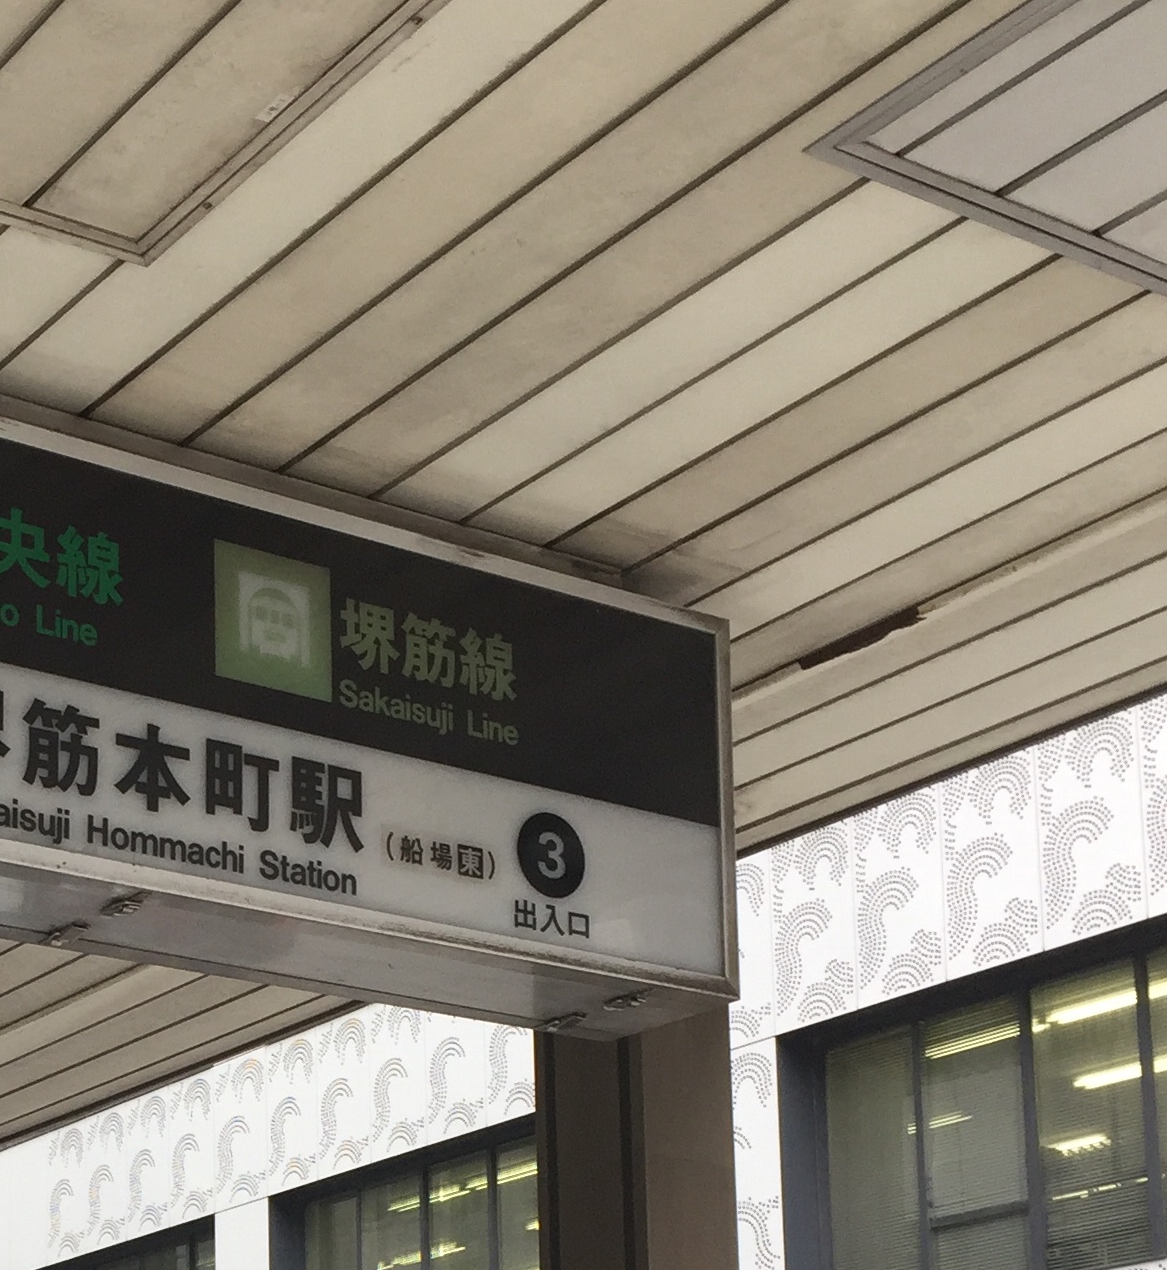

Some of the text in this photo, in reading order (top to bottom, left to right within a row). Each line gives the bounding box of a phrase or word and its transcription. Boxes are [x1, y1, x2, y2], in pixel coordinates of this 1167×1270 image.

[36, 608, 99, 647] Line
[339, 598, 518, 700] 堺筋線
[339, 679, 520, 746] Sakaisuji Line
[87, 814, 245, 875] Hommachi
[259, 850, 358, 896] Station
[537, 831, 567, 880] 3
[514, 899, 591, 939] 出入口
